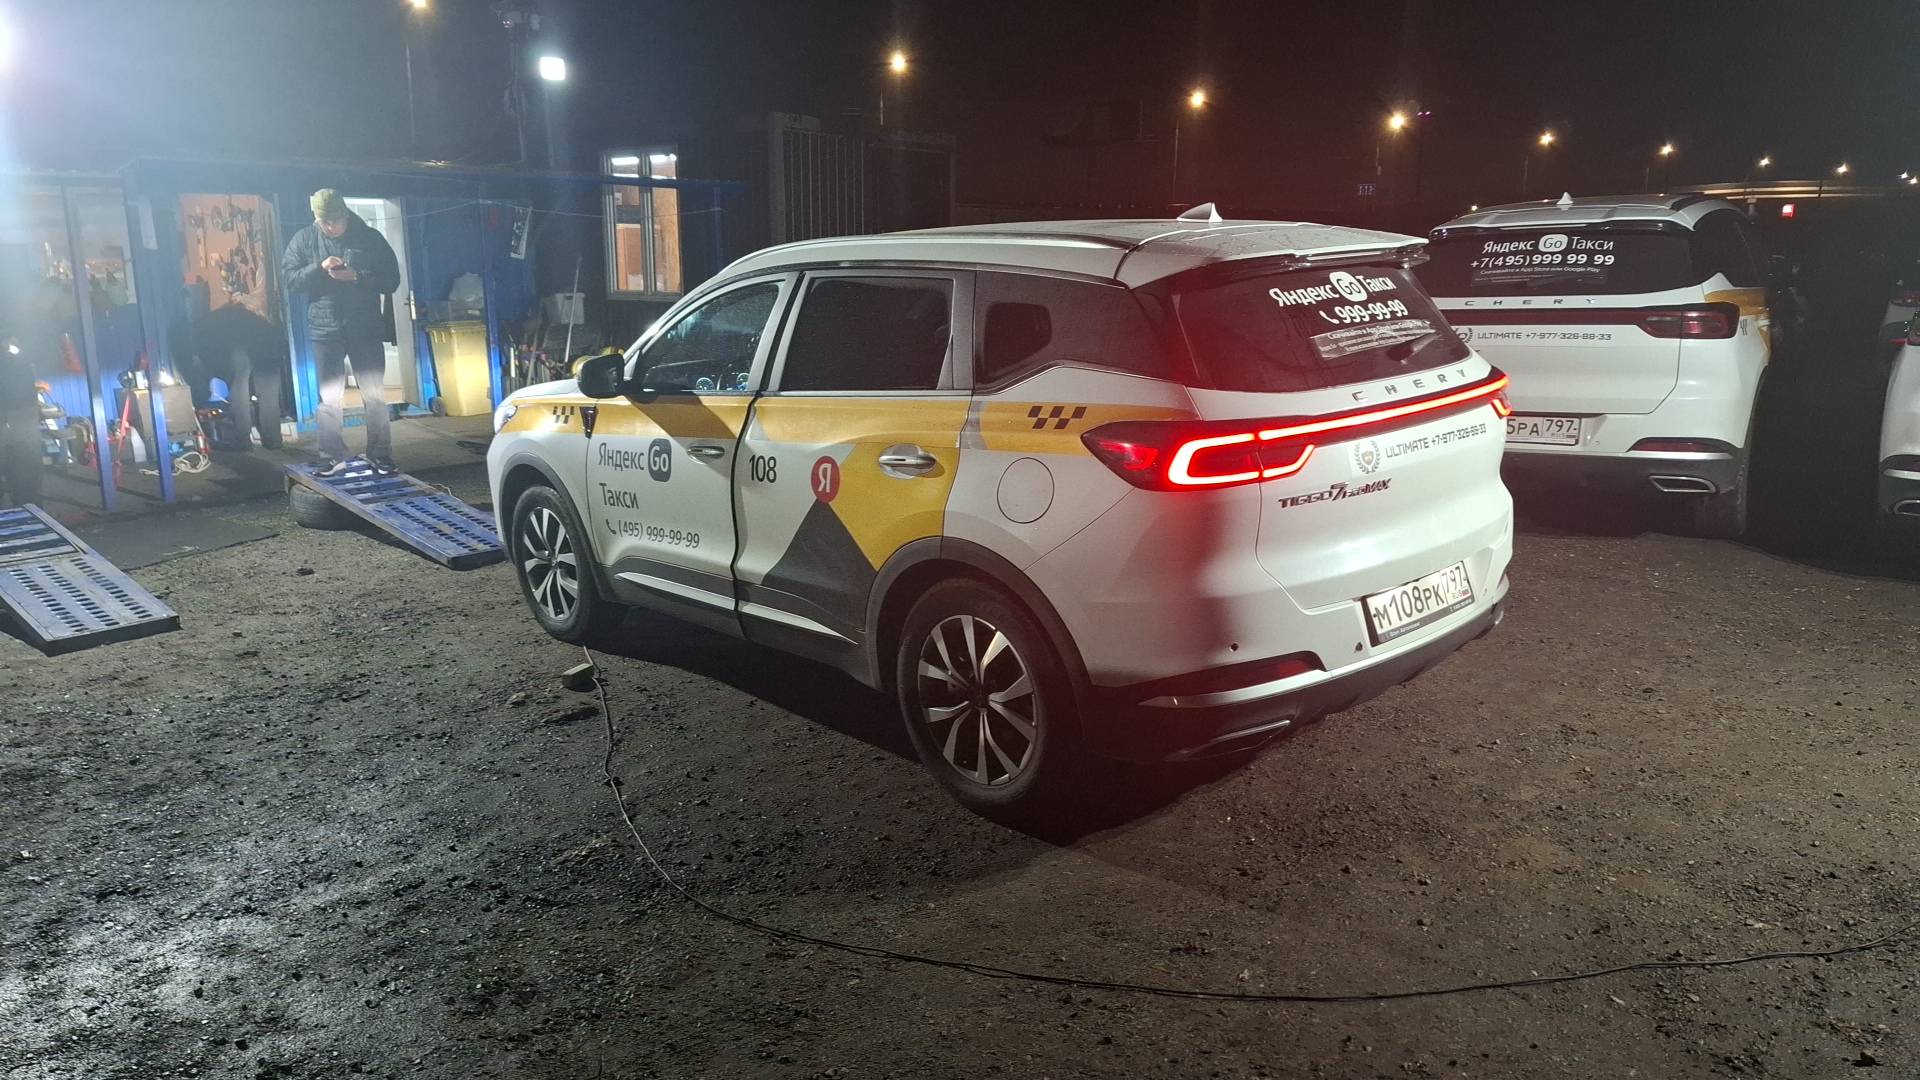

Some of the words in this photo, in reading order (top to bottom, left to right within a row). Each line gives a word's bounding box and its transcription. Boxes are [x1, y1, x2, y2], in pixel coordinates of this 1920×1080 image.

[1482, 240, 1536, 254] Яндекс
[1571, 236, 1614, 251] Такси
[1566, 253, 1588, 265] 99
[1593, 254, 1615, 266] 99
[1269, 283, 1340, 307] Яндекс
[1356, 275, 1397, 293] Такси
[1464, 298, 1597, 306] CHERY
[1334, 299, 1408, 324] 999-99-99
[1477, 332, 1522, 340] ULTIMATE
[1526, 332, 1612, 341] +7-977-326-88-33
[1351, 369, 1467, 402] CHERY
[1545, 419, 1575, 433] 797
[598, 443, 645, 472] Яндекс
[1385, 437, 1430, 458] ULTIMATE
[749, 455, 777, 483] 108
[817, 463, 832, 493] Я
[598, 482, 640, 510] Такси
[618, 519, 644, 538] (495)
[646, 524, 700, 549] 999-99-99
